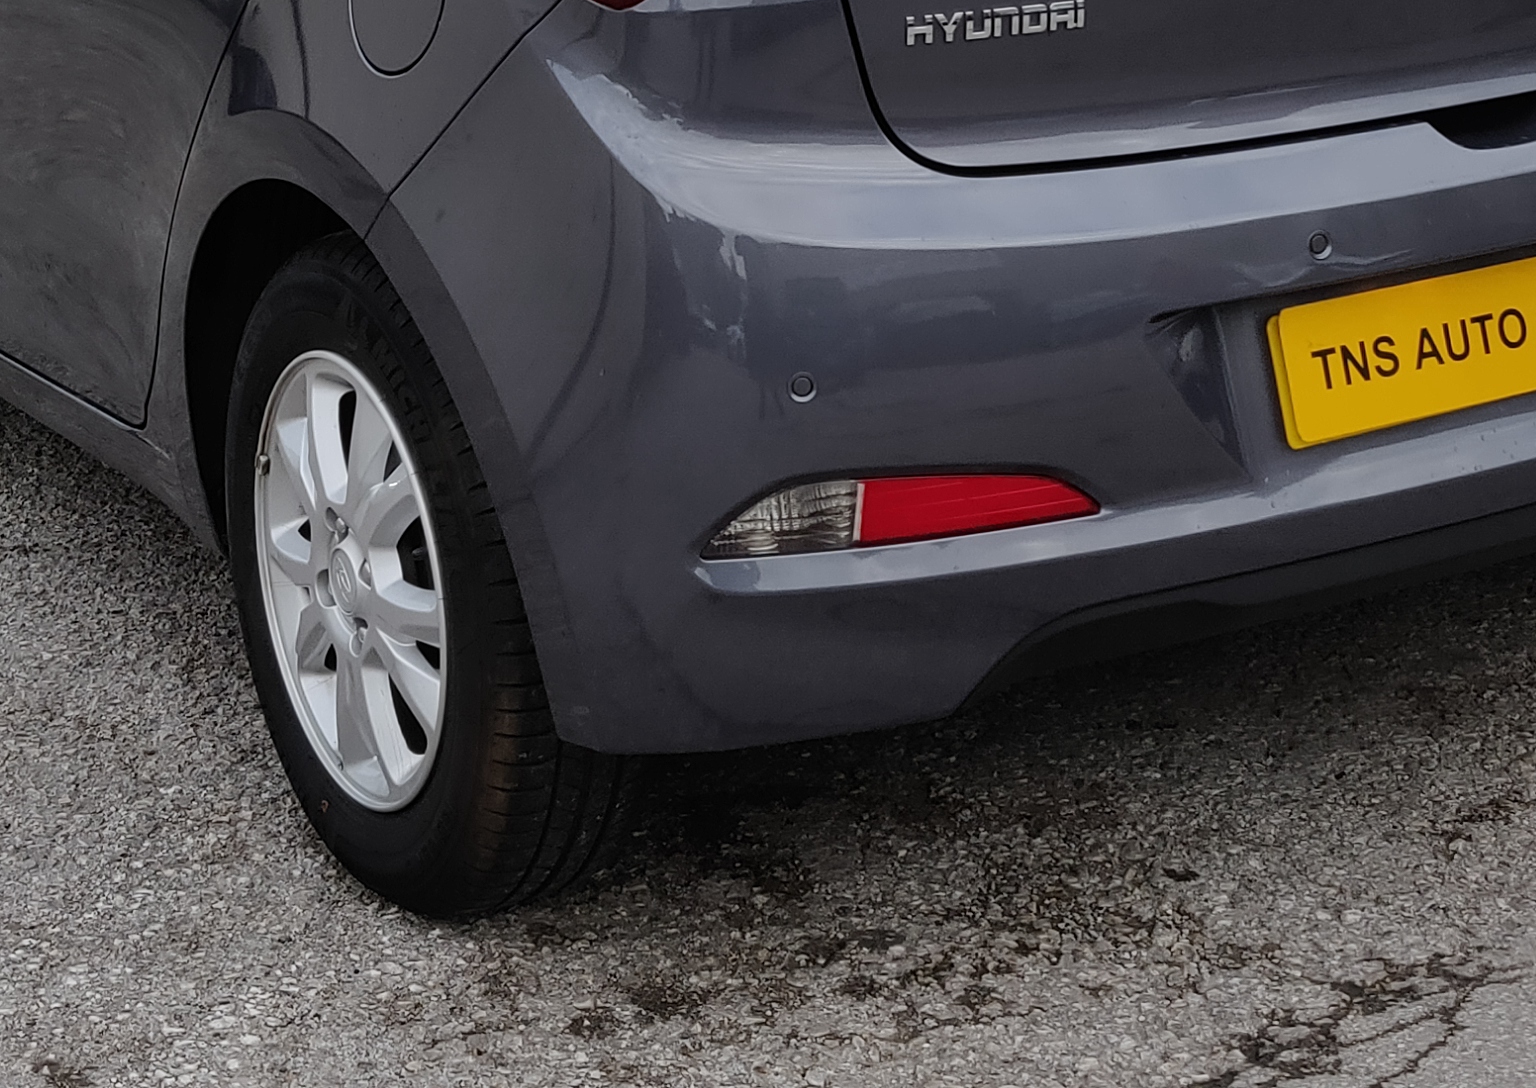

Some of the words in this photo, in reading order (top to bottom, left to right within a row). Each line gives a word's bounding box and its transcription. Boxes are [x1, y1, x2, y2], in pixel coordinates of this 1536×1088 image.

[906, 0, 1085, 46] HYUNDAI
[1311, 335, 1400, 390] TNS
[1415, 308, 1527, 370] AUTO
